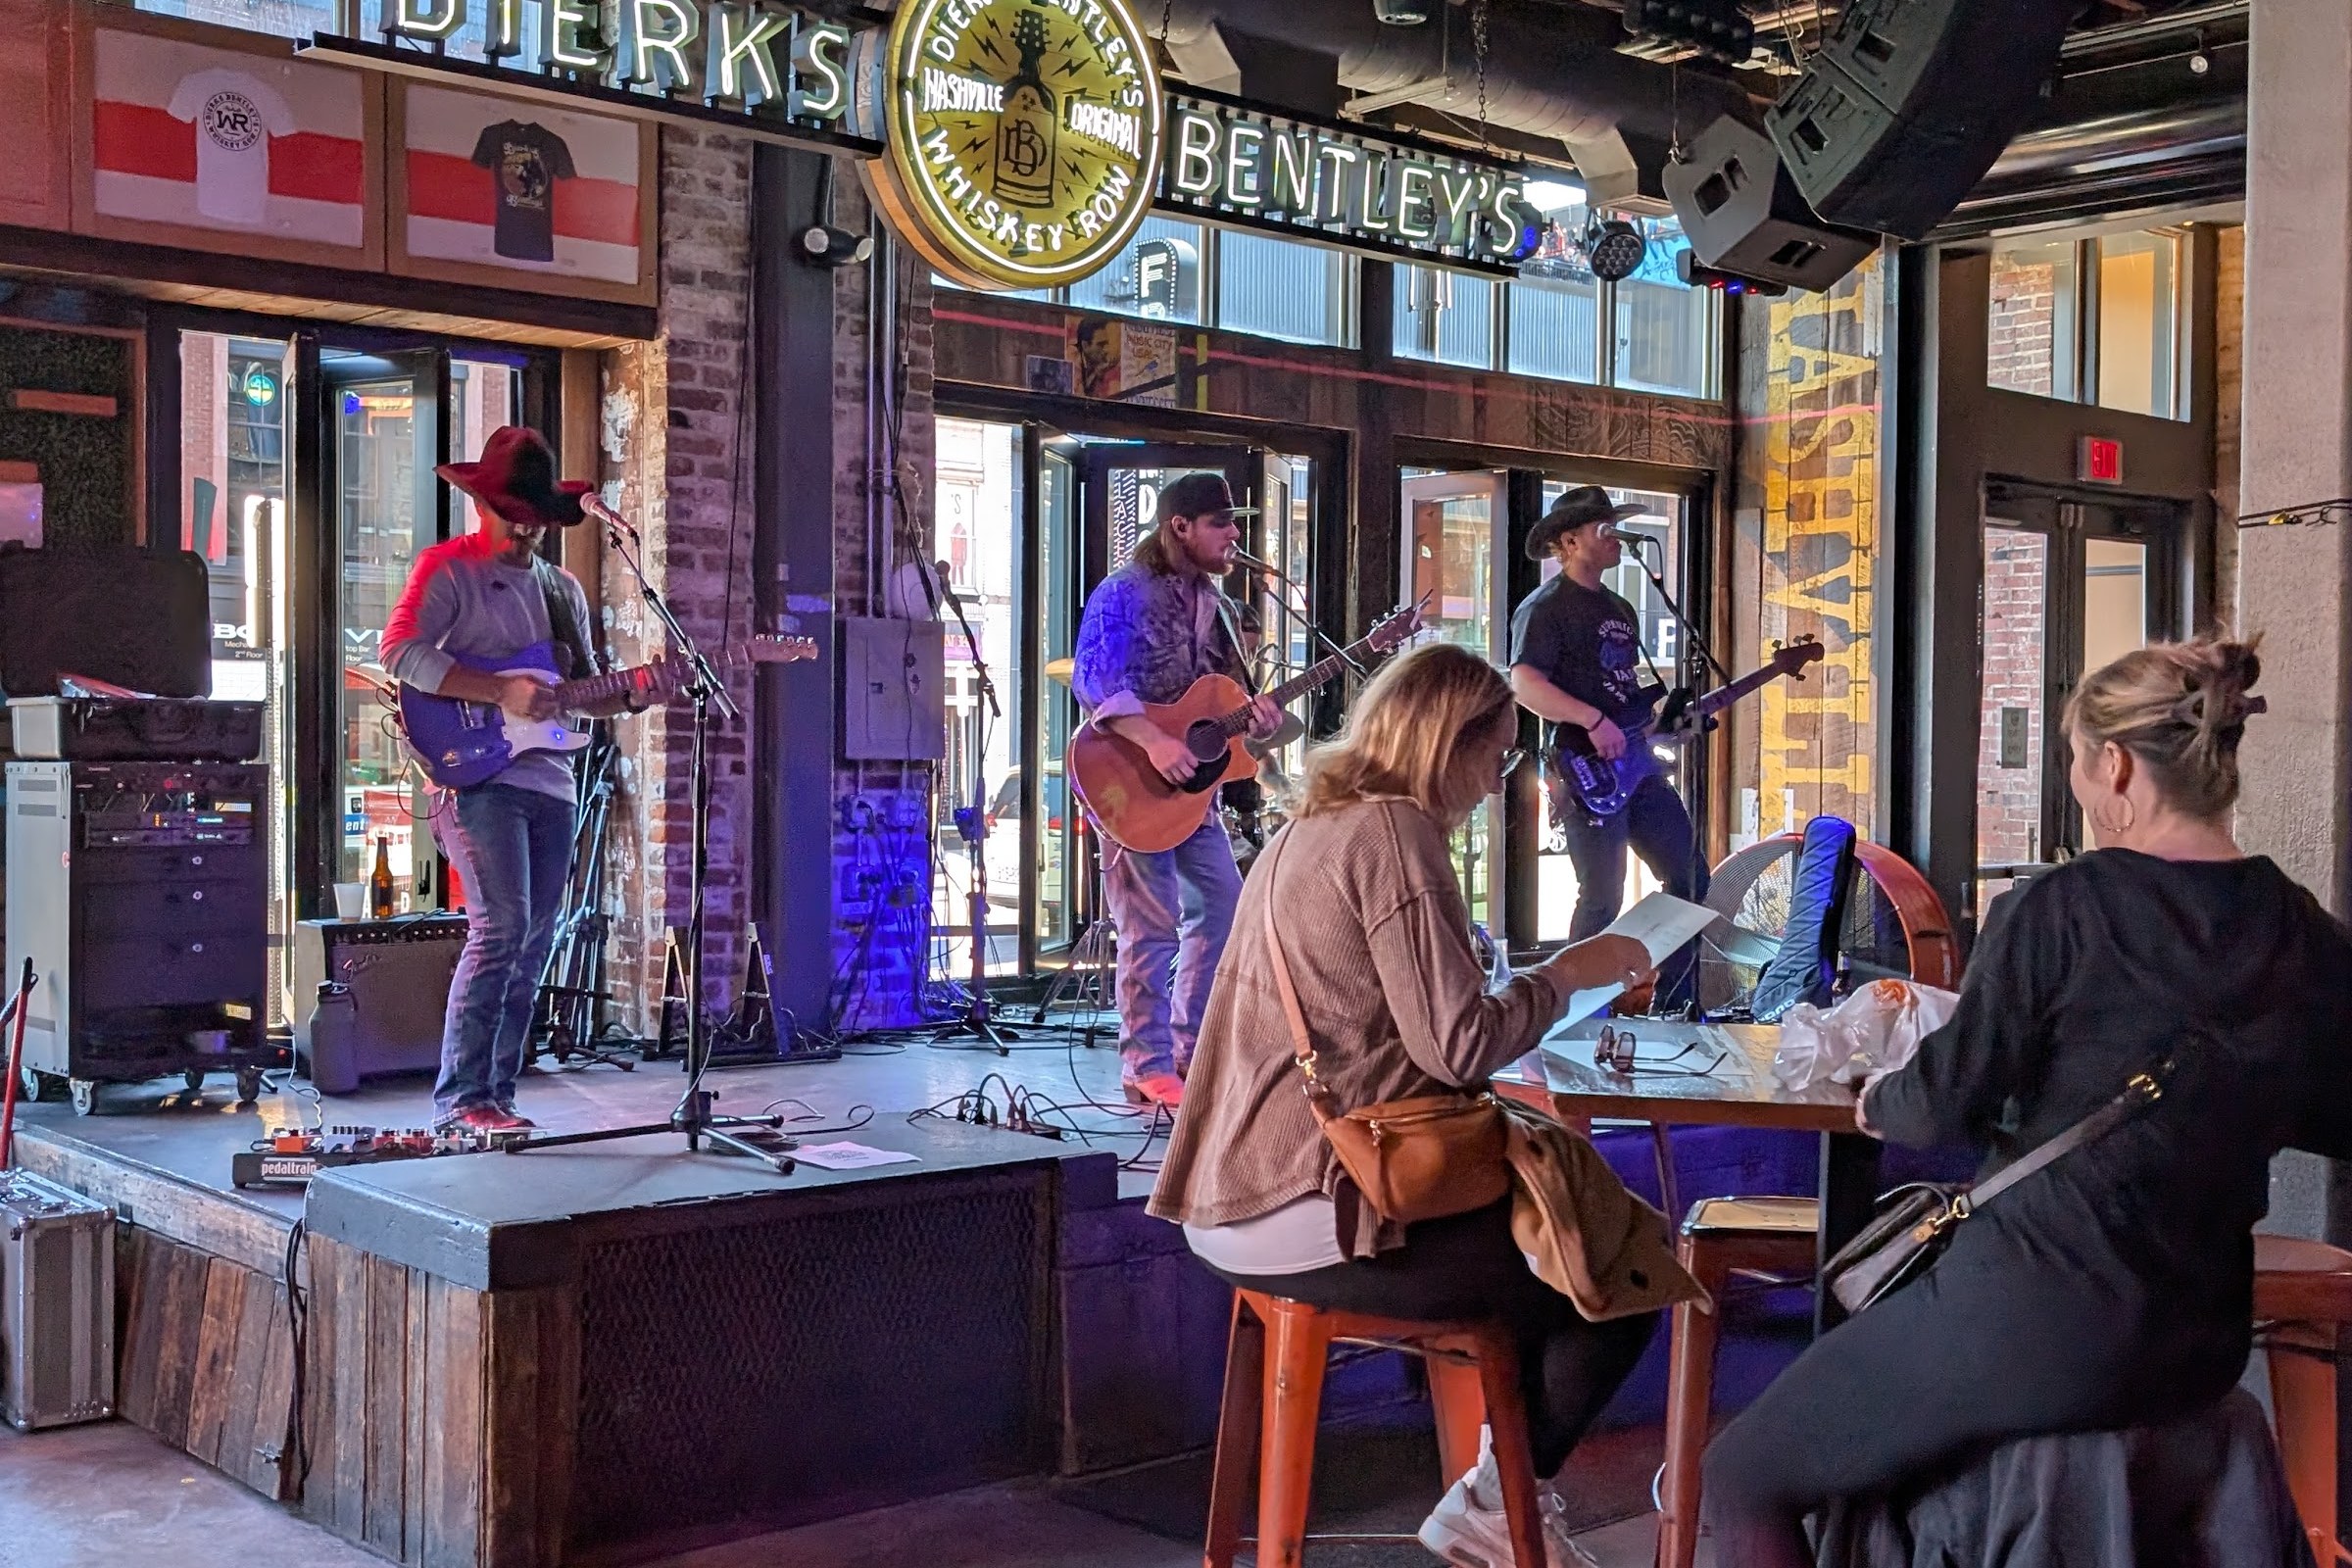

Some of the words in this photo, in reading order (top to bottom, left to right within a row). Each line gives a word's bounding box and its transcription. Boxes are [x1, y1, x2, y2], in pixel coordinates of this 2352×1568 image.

[923, 67, 1004, 114] NASHVILLE
[1070, 102, 1142, 160] ORIGINAL
[926, 129, 1064, 253] WHISKEY
[1079, 165, 1131, 238] ROW
[1177, 112, 1521, 254] BENTLEY'S
[1761, 251, 1876, 845] NASHVILL
[261, 1162, 318, 1177] pedaltrain
